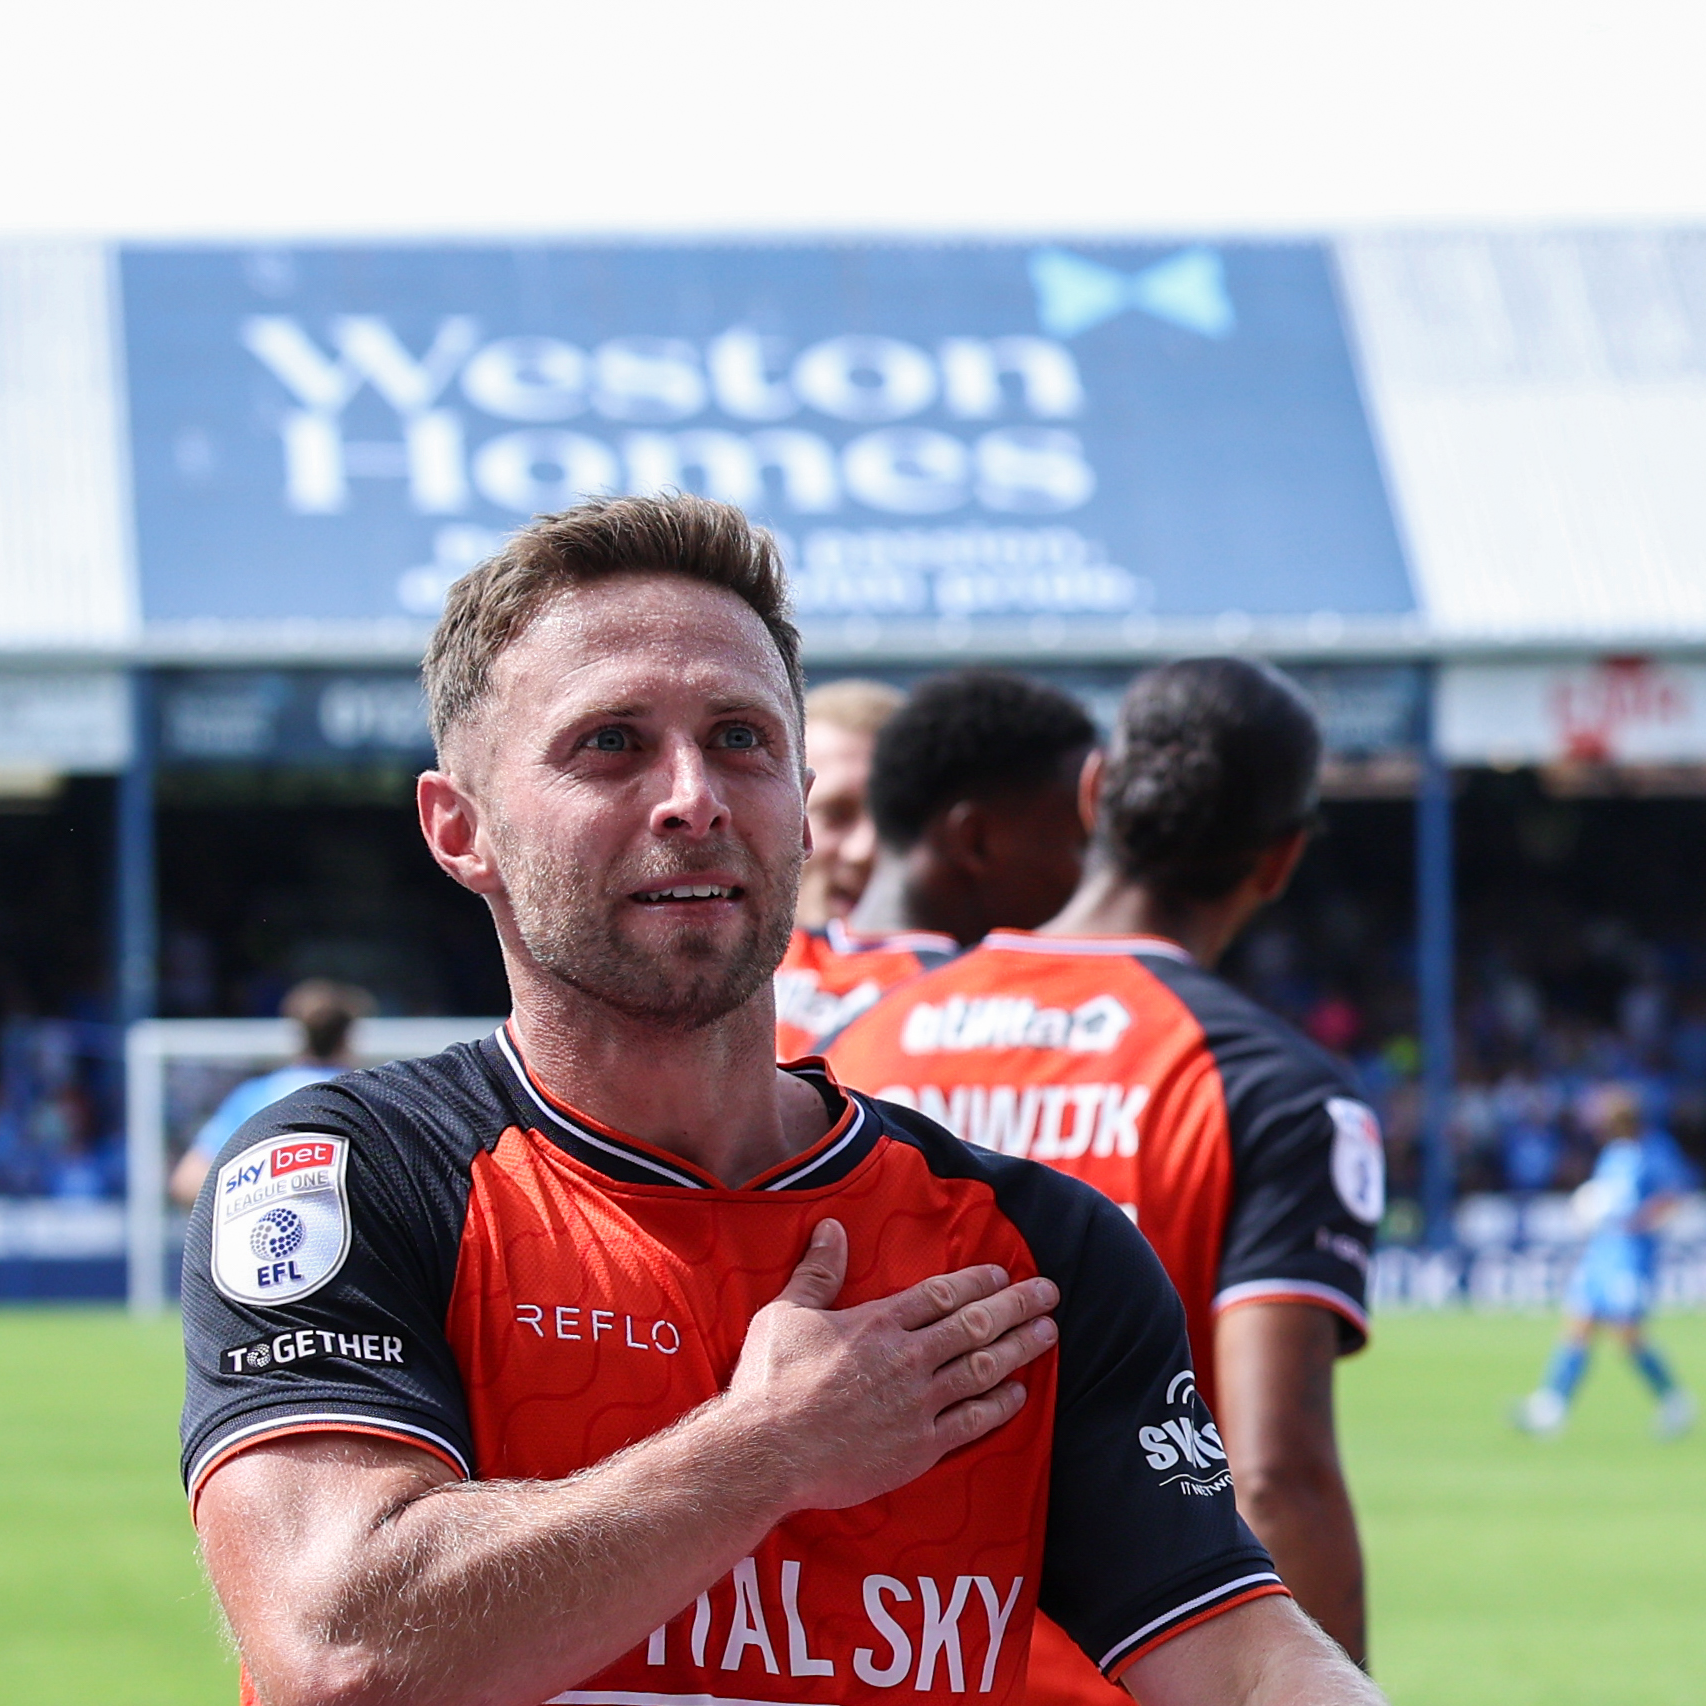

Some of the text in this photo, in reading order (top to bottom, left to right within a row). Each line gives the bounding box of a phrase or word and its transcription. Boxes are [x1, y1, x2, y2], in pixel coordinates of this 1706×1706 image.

[238, 313, 1086, 421] Weston
[282, 406, 1092, 514] Homes
[225, 1143, 328, 1195] sky bet
[225, 1169, 330, 1217] LEAGUE ONE
[257, 1260, 304, 1287] EFL
[515, 1303, 682, 1355] REFLO
[1193, 1473, 1235, 1497] NETWO
[852, 1573, 1024, 1694] SKY
